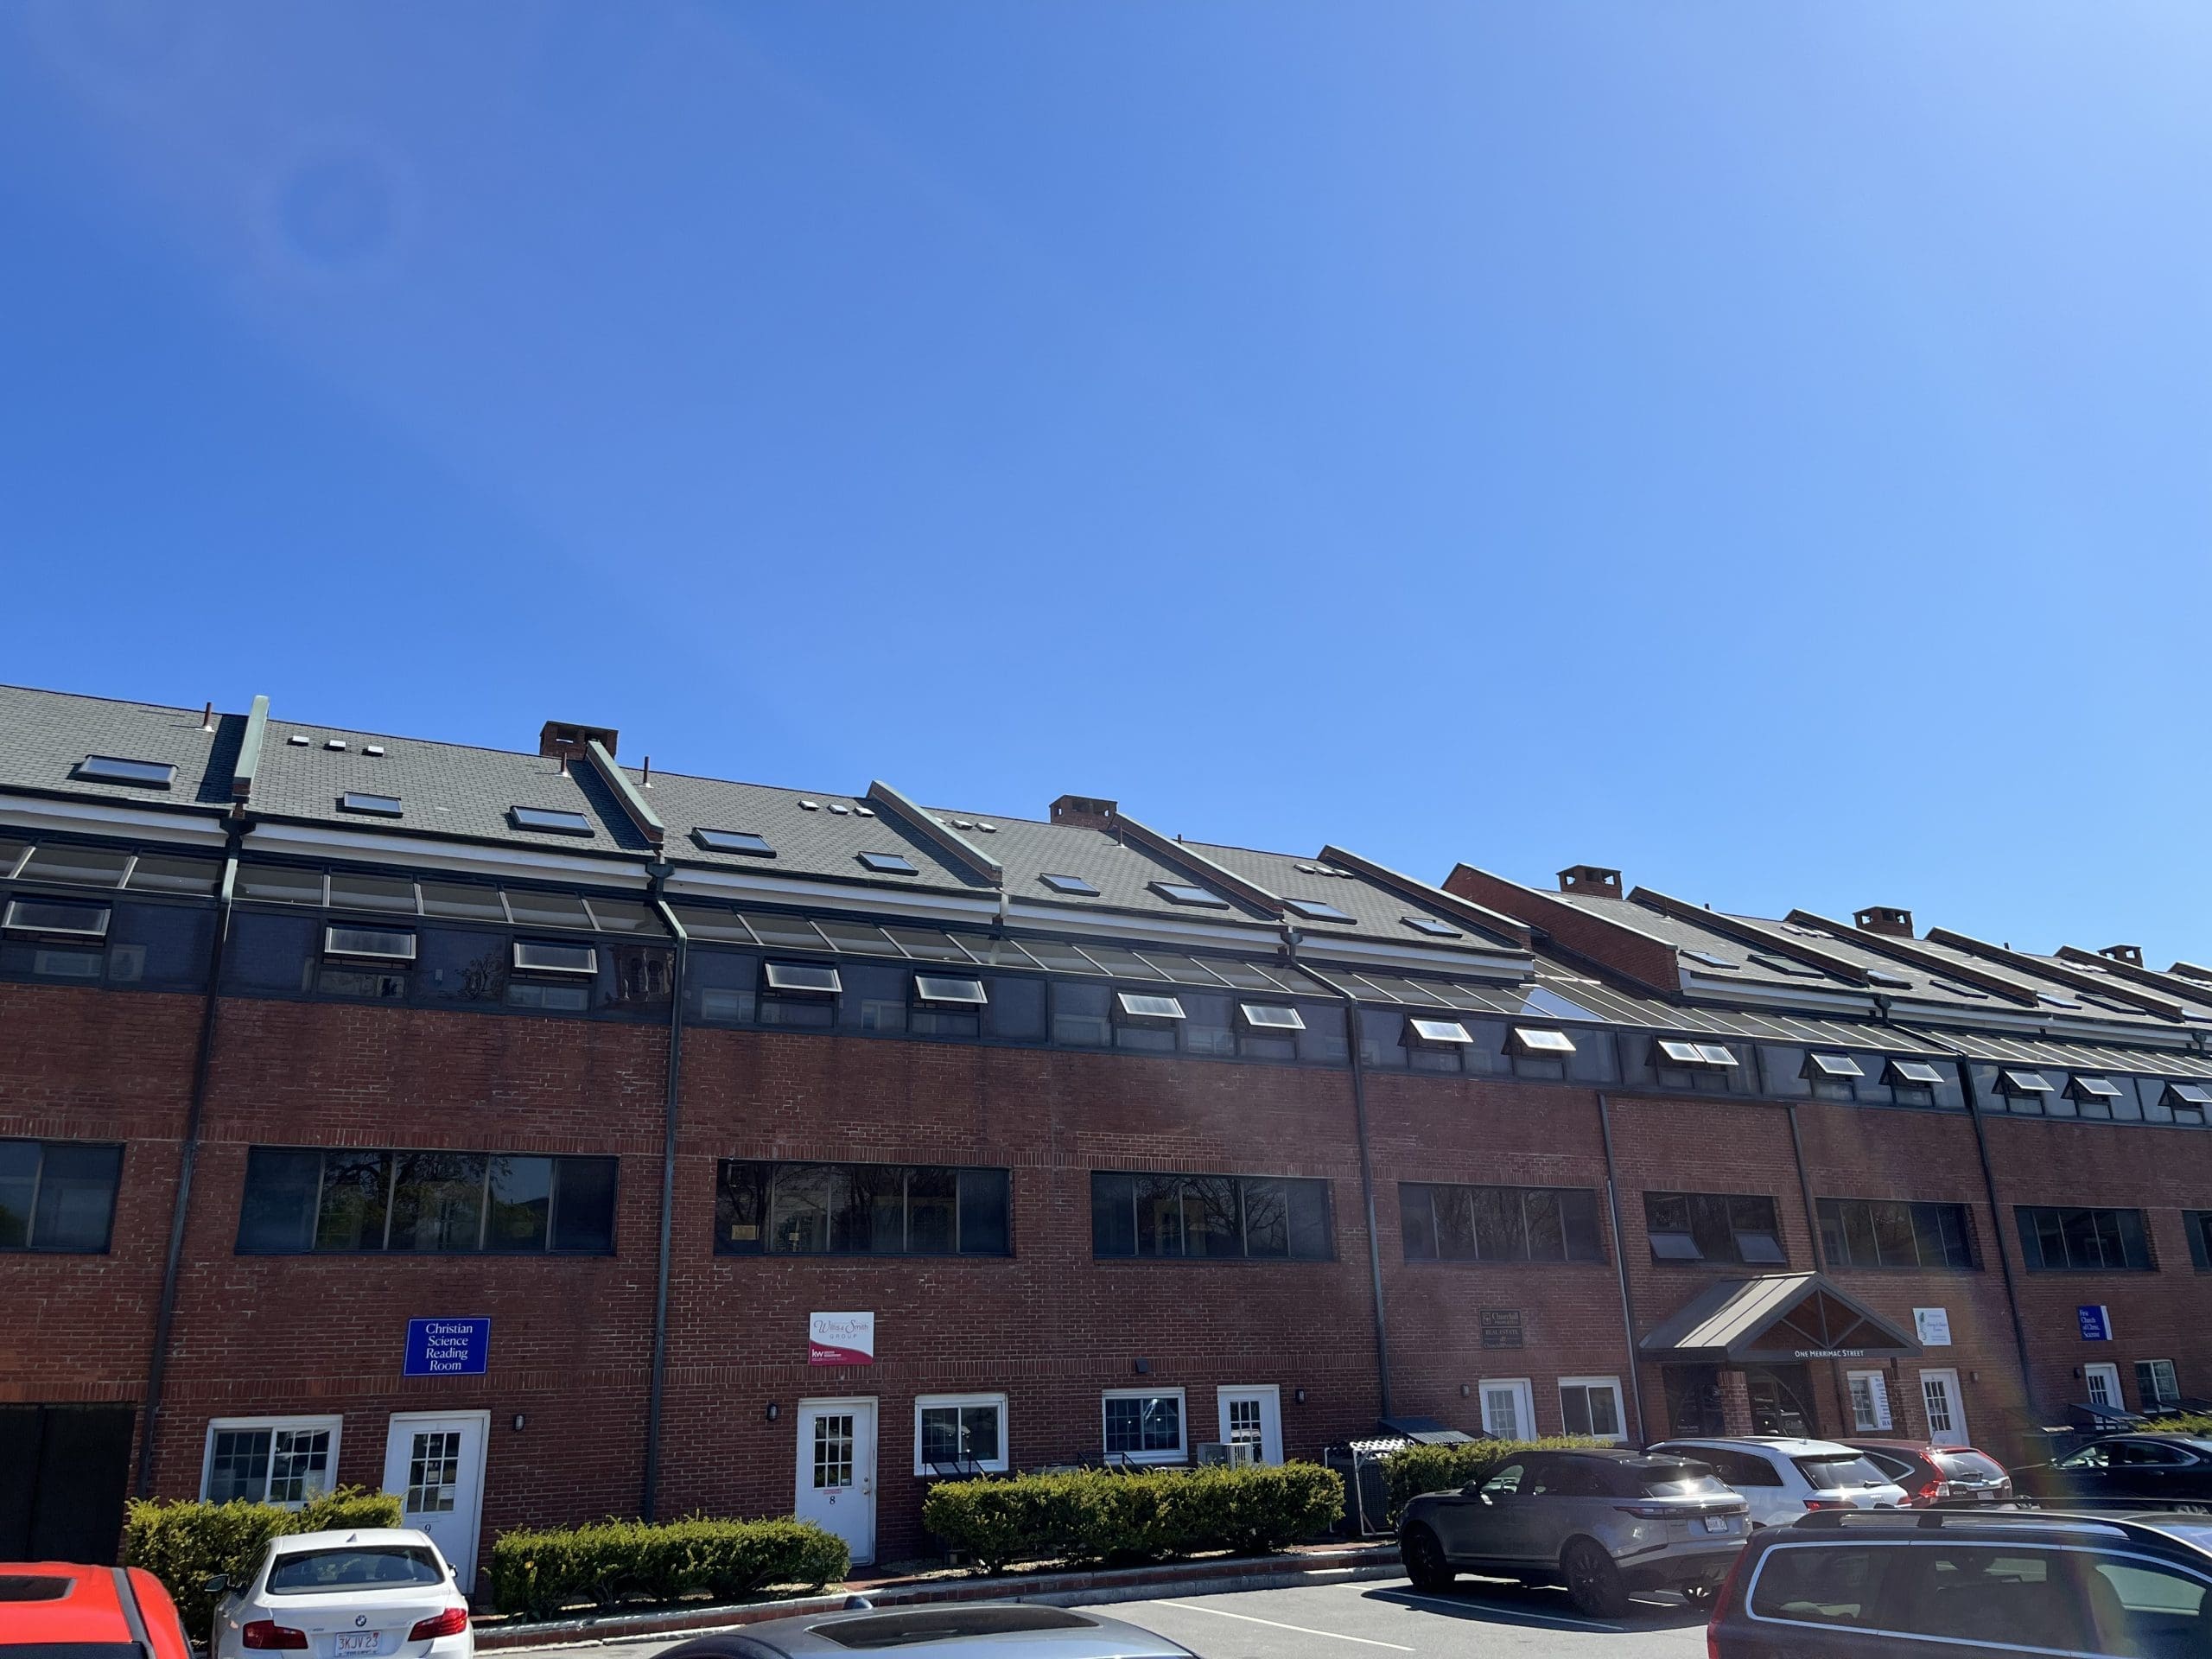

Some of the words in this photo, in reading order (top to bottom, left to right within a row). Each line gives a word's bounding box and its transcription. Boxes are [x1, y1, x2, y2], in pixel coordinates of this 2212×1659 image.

[425, 1323, 474, 1334] Christian
[428, 1335, 468, 1347] Science
[426, 1347, 468, 1361] Reading
[811, 1349, 824, 1358] kw
[1842, 1349, 1864, 1357] STREET
[429, 1360, 462, 1371] Room
[829, 1495, 836, 1505] 8
[424, 1523, 432, 1533] 9
